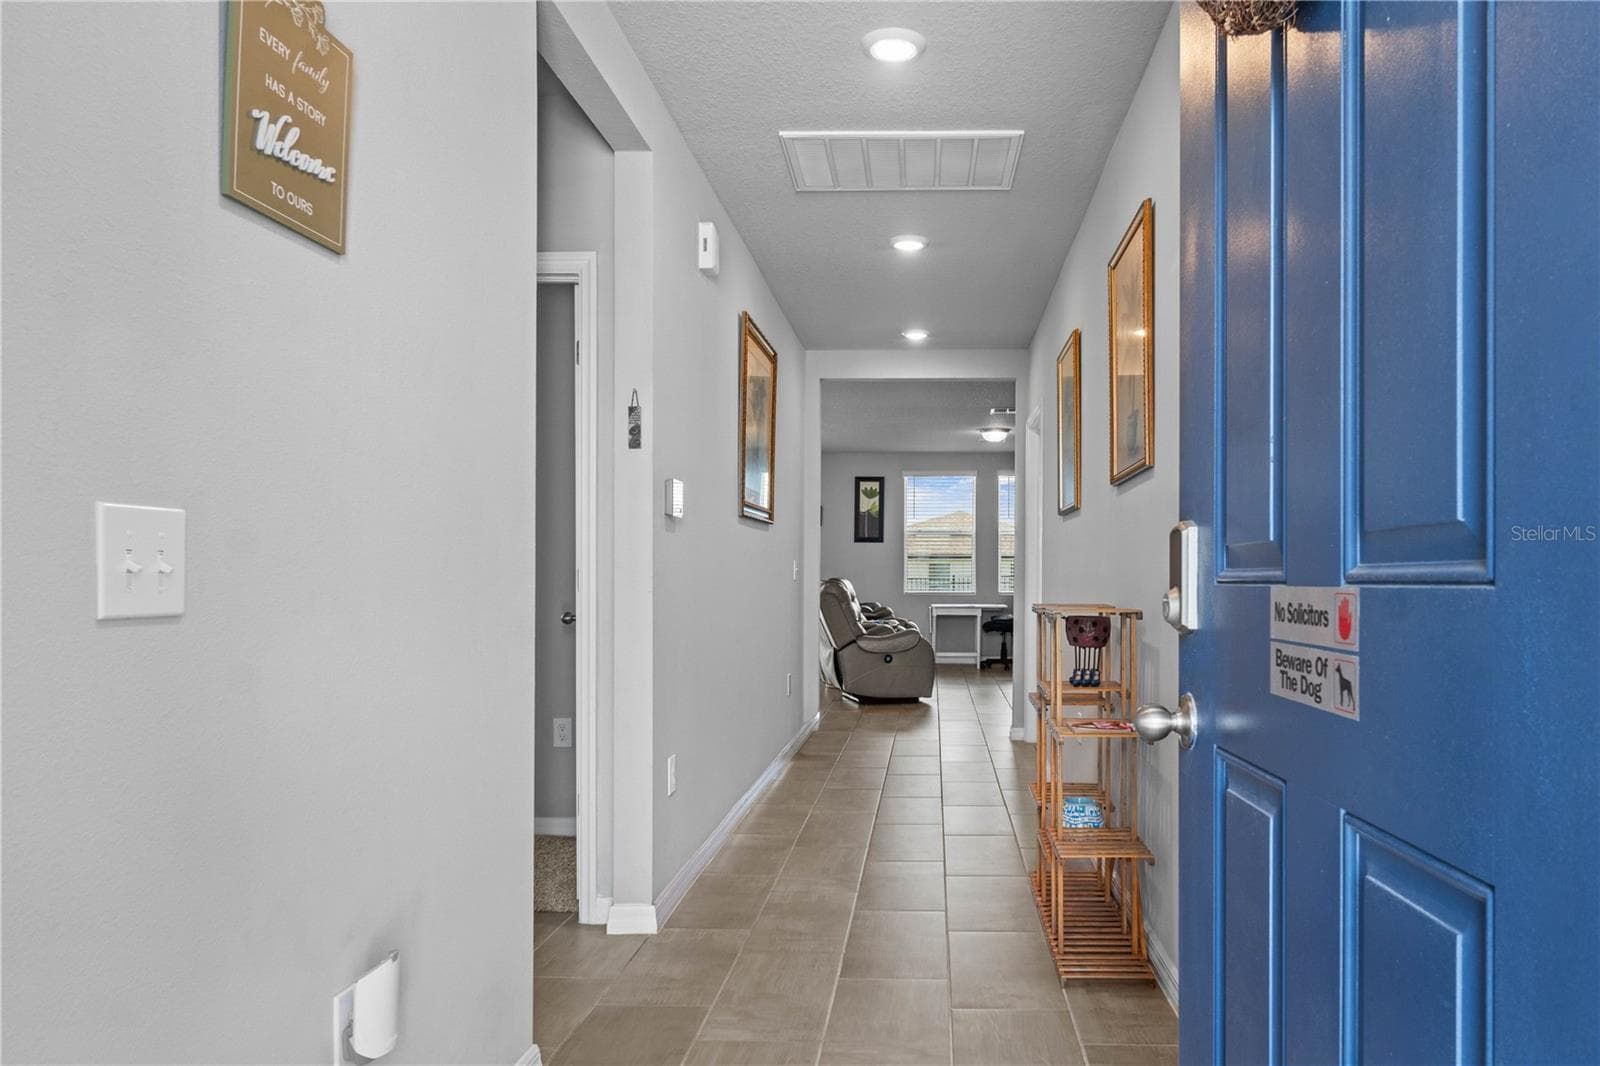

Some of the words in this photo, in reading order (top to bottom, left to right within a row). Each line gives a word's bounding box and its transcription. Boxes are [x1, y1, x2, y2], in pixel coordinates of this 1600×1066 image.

[259, 27, 291, 60] EVERY
[292, 50, 330, 94] family
[265, 74, 286, 98] HAS
[288, 92, 294, 105] A
[297, 98, 326, 127] STORY
[251, 109, 336, 183] Welcome
[271, 181, 285, 199] TO
[287, 193, 314, 216] OURS
[1274, 601, 1285, 623] No
[1287, 602, 1329, 628] Solicitors
[1275, 648, 1312, 675] Beware
[1315, 656, 1328, 678] Of
[1280, 670, 1298, 692] The
[1300, 675, 1322, 704] Dog
